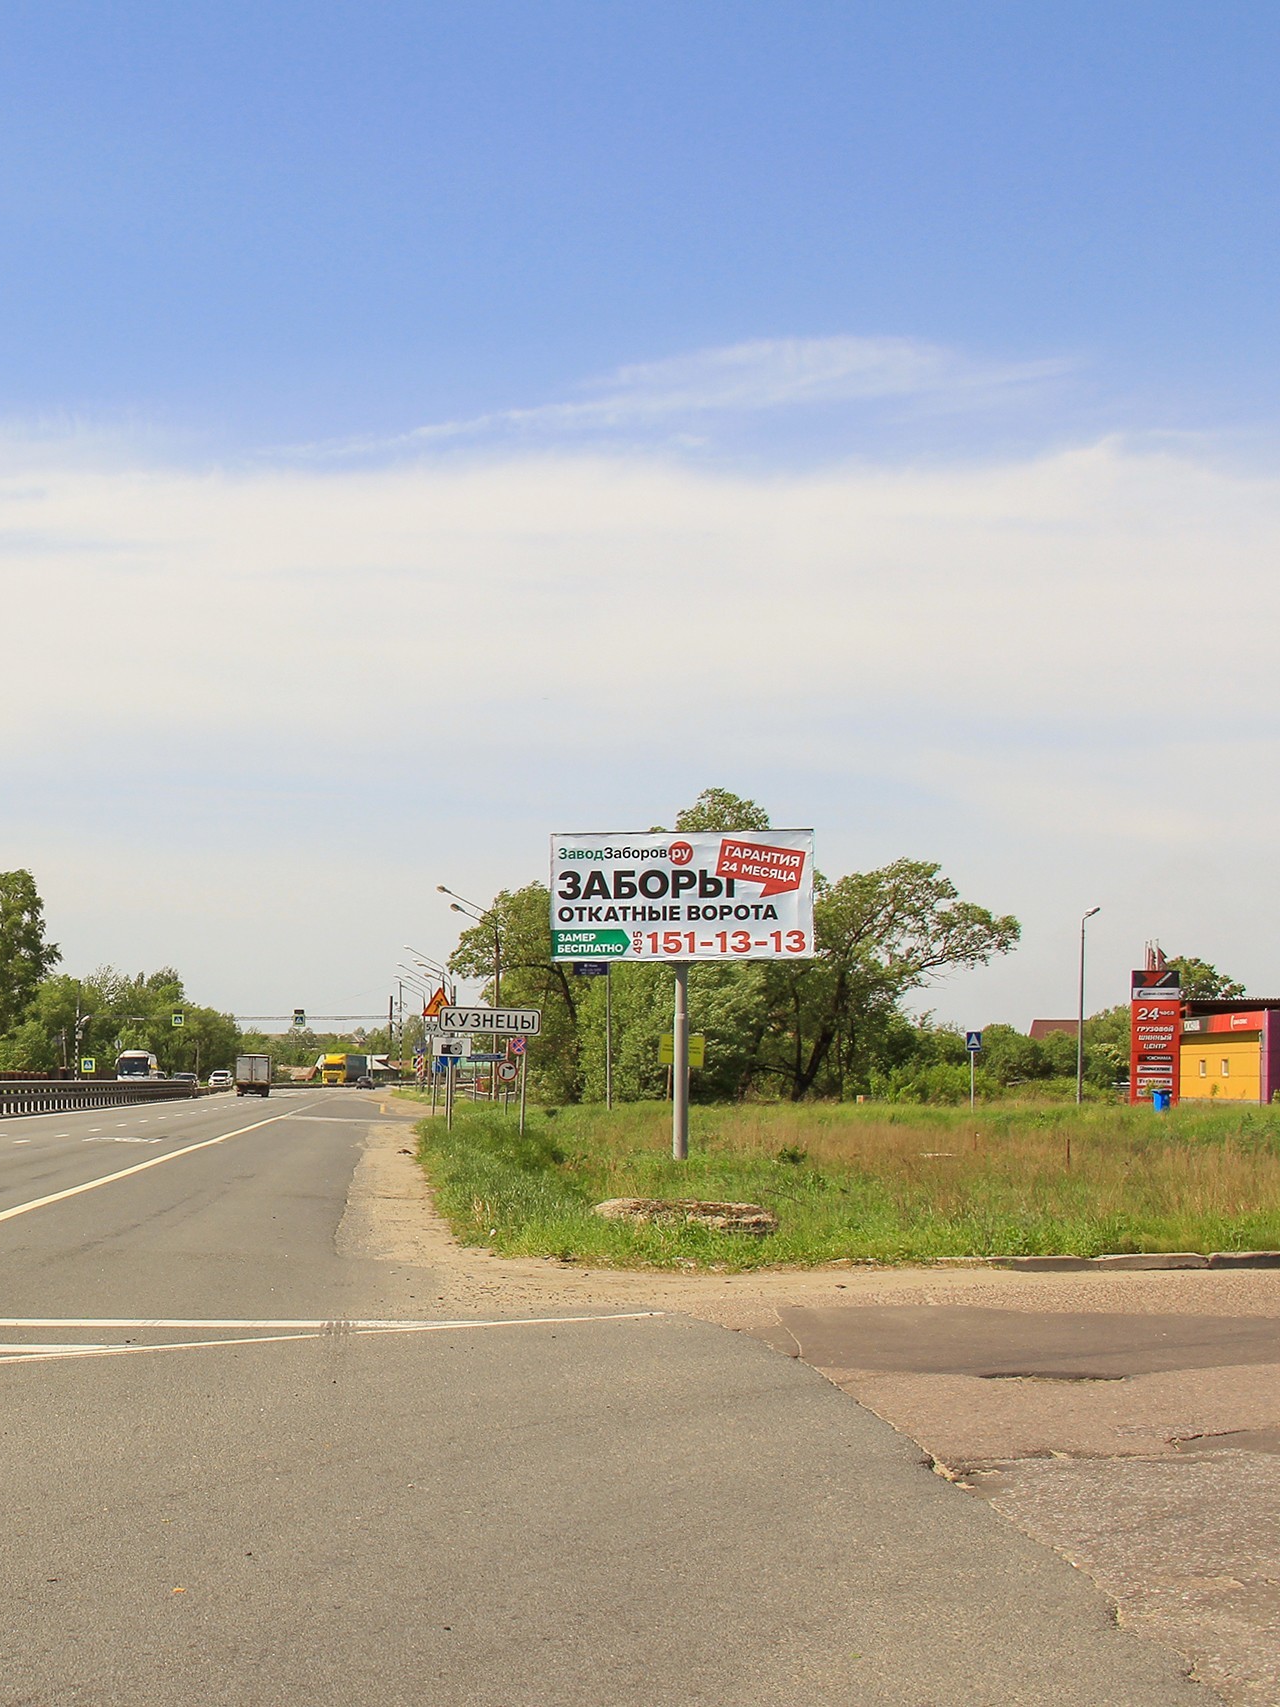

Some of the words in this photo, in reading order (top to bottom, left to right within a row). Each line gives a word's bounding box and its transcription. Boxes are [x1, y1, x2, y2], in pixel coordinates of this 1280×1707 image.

[724, 845, 800, 868] ГАРАНТИЯ
[721, 861, 738, 872] 24
[740, 864, 797, 883] МЕСЯЦА
[557, 869, 735, 900] ЗАБОРЫ
[557, 905, 681, 922] ОТКАТНЫЕ
[687, 904, 778, 920] ВОРОТА
[557, 933, 596, 942] ЗАМЕР
[632, 930, 643, 955] 495
[646, 930, 806, 954] 151-13-13
[557, 943, 624, 953] БЕСПЛАТНО
[445, 1013, 535, 1031] КУЗНЕЦЫ
[1136, 1007, 1159, 1020] 24
